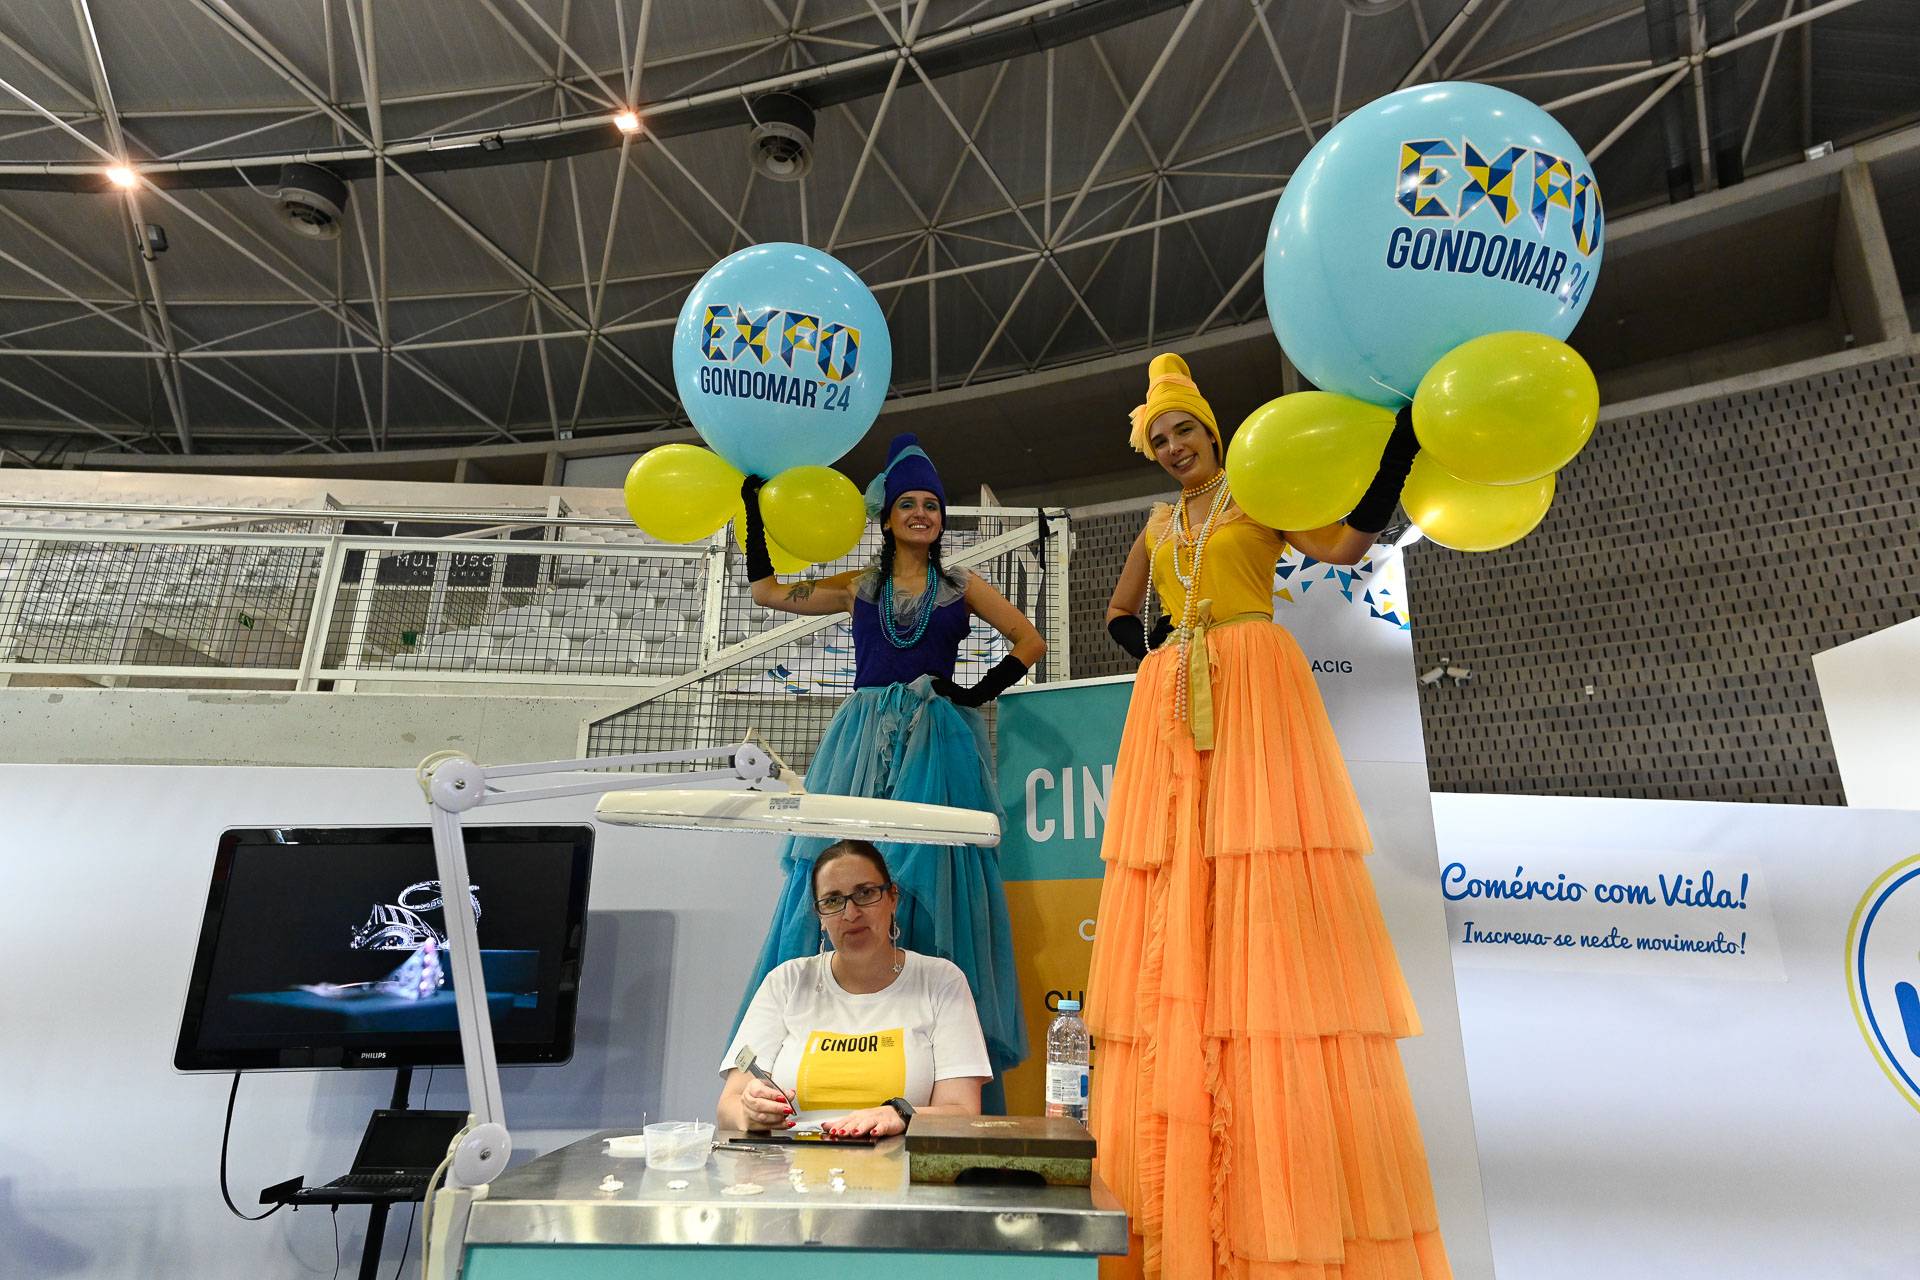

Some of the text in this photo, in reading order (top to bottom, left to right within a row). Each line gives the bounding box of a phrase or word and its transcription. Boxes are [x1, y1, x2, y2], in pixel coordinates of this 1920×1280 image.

[1396, 137, 1604, 257] EXPO
[1386, 226, 1567, 294] GONDOMAR
[701, 305, 861, 382] EXPO
[700, 366, 818, 408] GONDOMAR
[1311, 660, 1353, 673] ACIG
[1025, 764, 1113, 842] CIN
[1441, 862, 1749, 909] Comércio com Vida!
[1462, 921, 1746, 954] Inscreva-se neste movimento!
[821, 1035, 878, 1052] CINDOR
